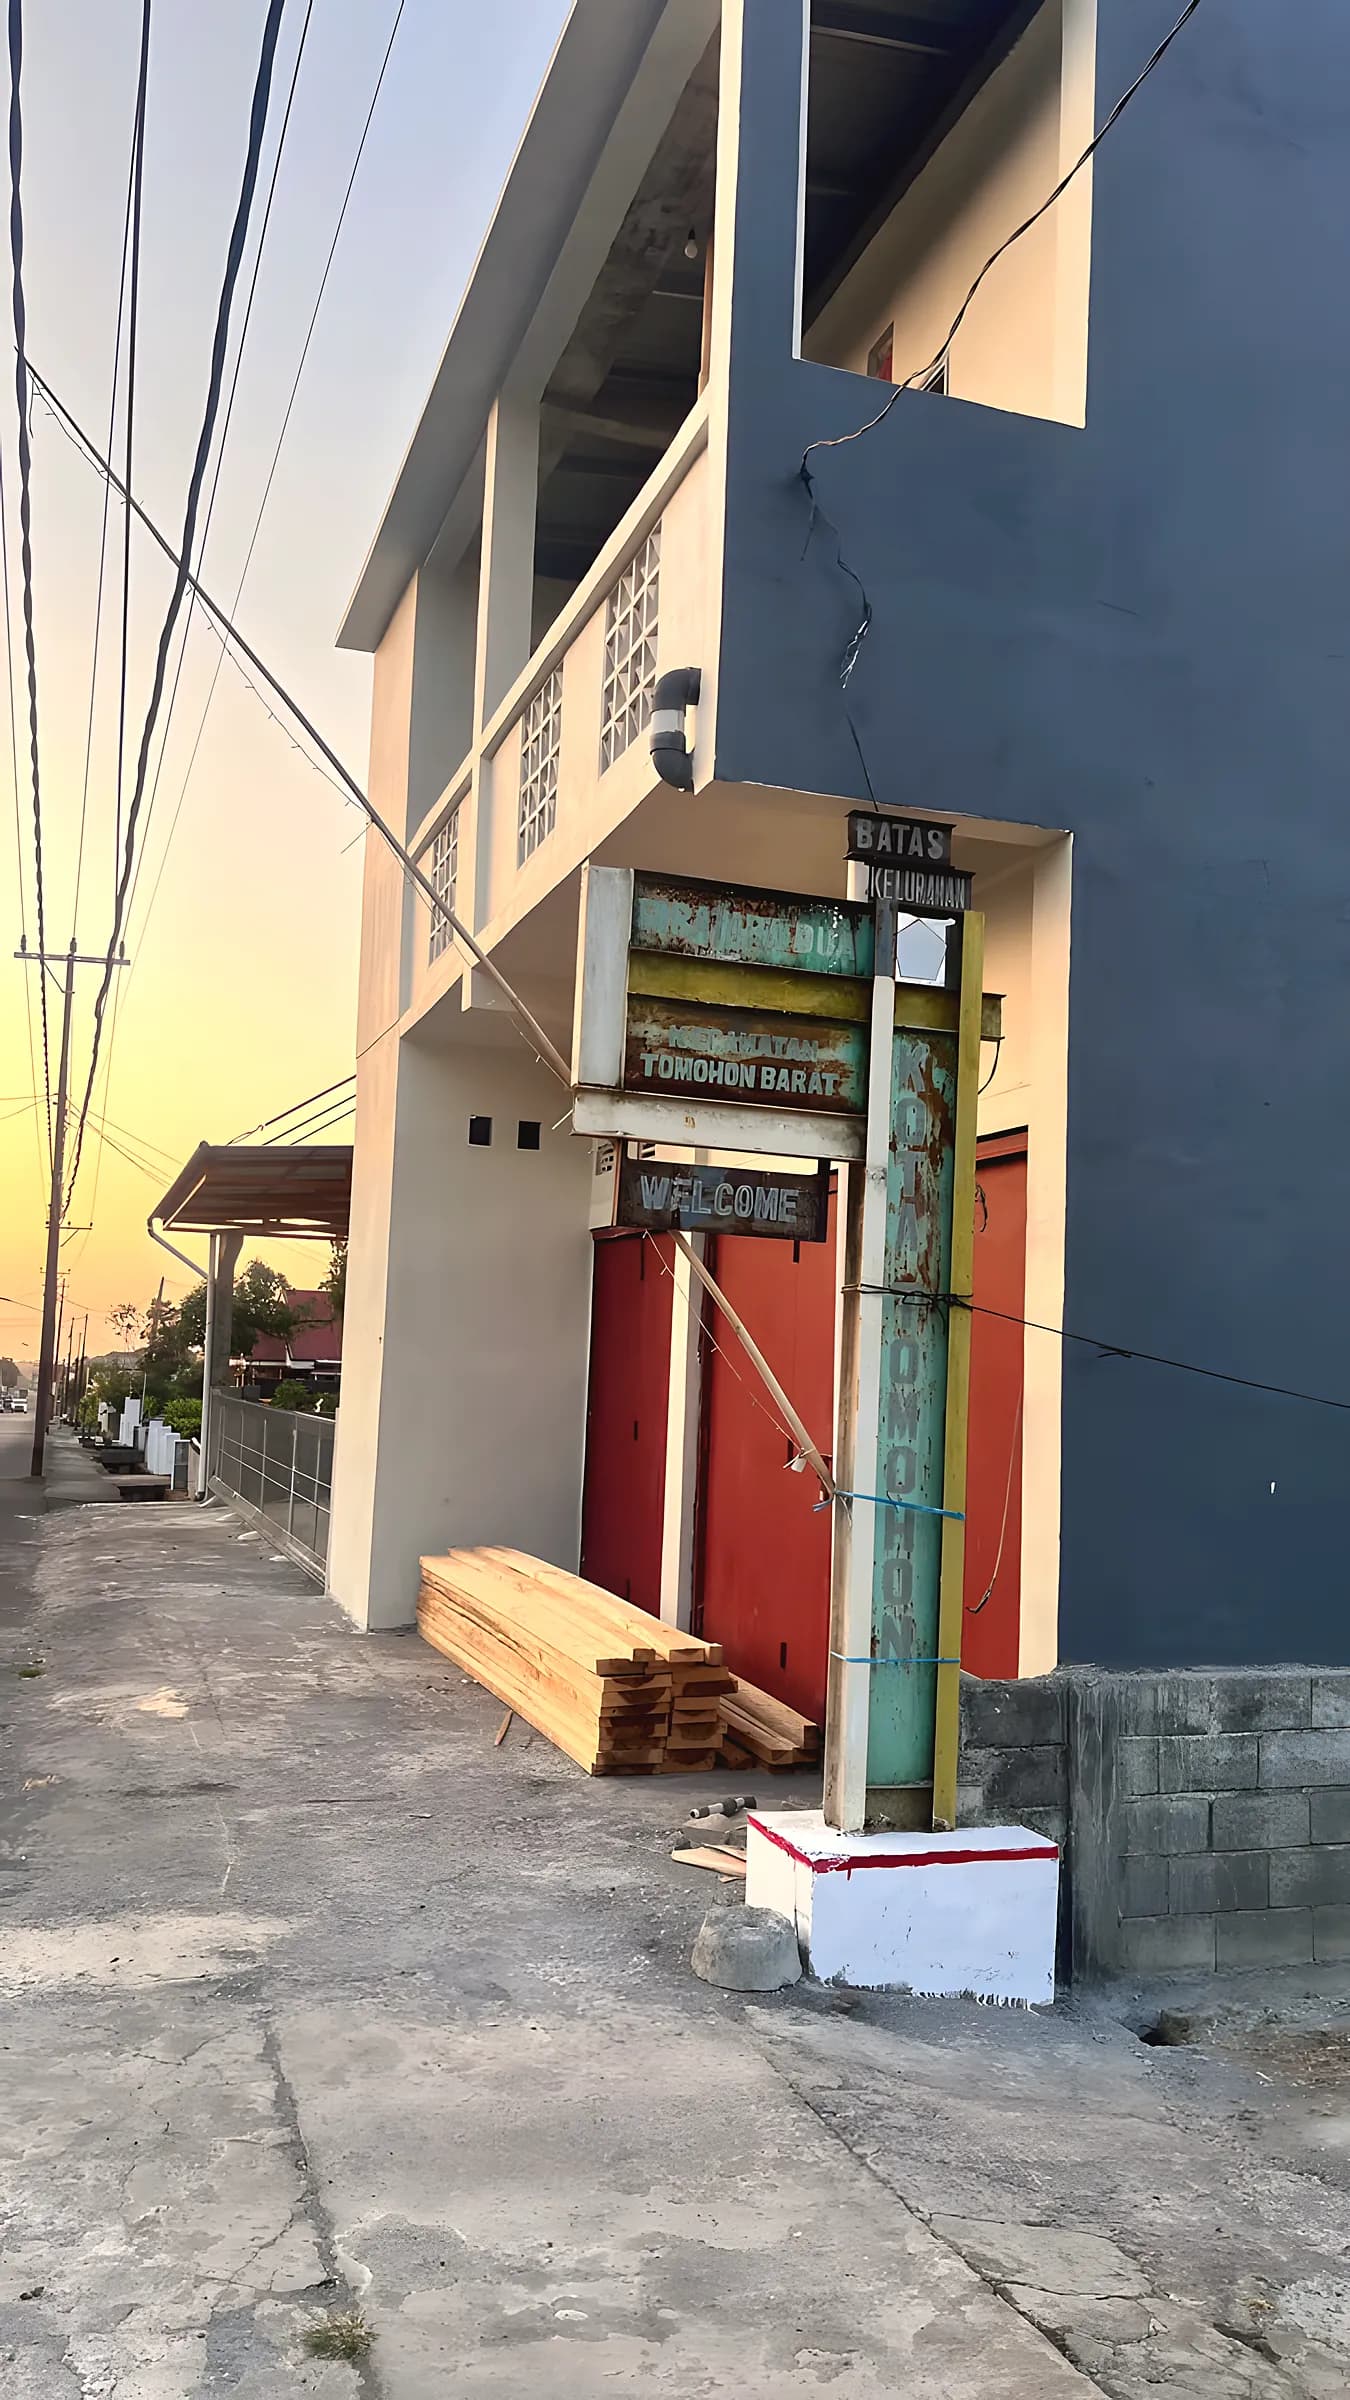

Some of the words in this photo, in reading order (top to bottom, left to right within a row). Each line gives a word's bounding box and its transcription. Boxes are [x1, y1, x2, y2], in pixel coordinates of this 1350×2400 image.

[856, 818, 944, 860] BATAS
[640, 1052, 756, 1089] TOMOHON
[760, 1066, 842, 1097] BARAT
[895, 1039, 930, 1252] KOTA
[640, 1174, 802, 1224] WELCOME
[881, 1281, 922, 1662] TOMOHON
